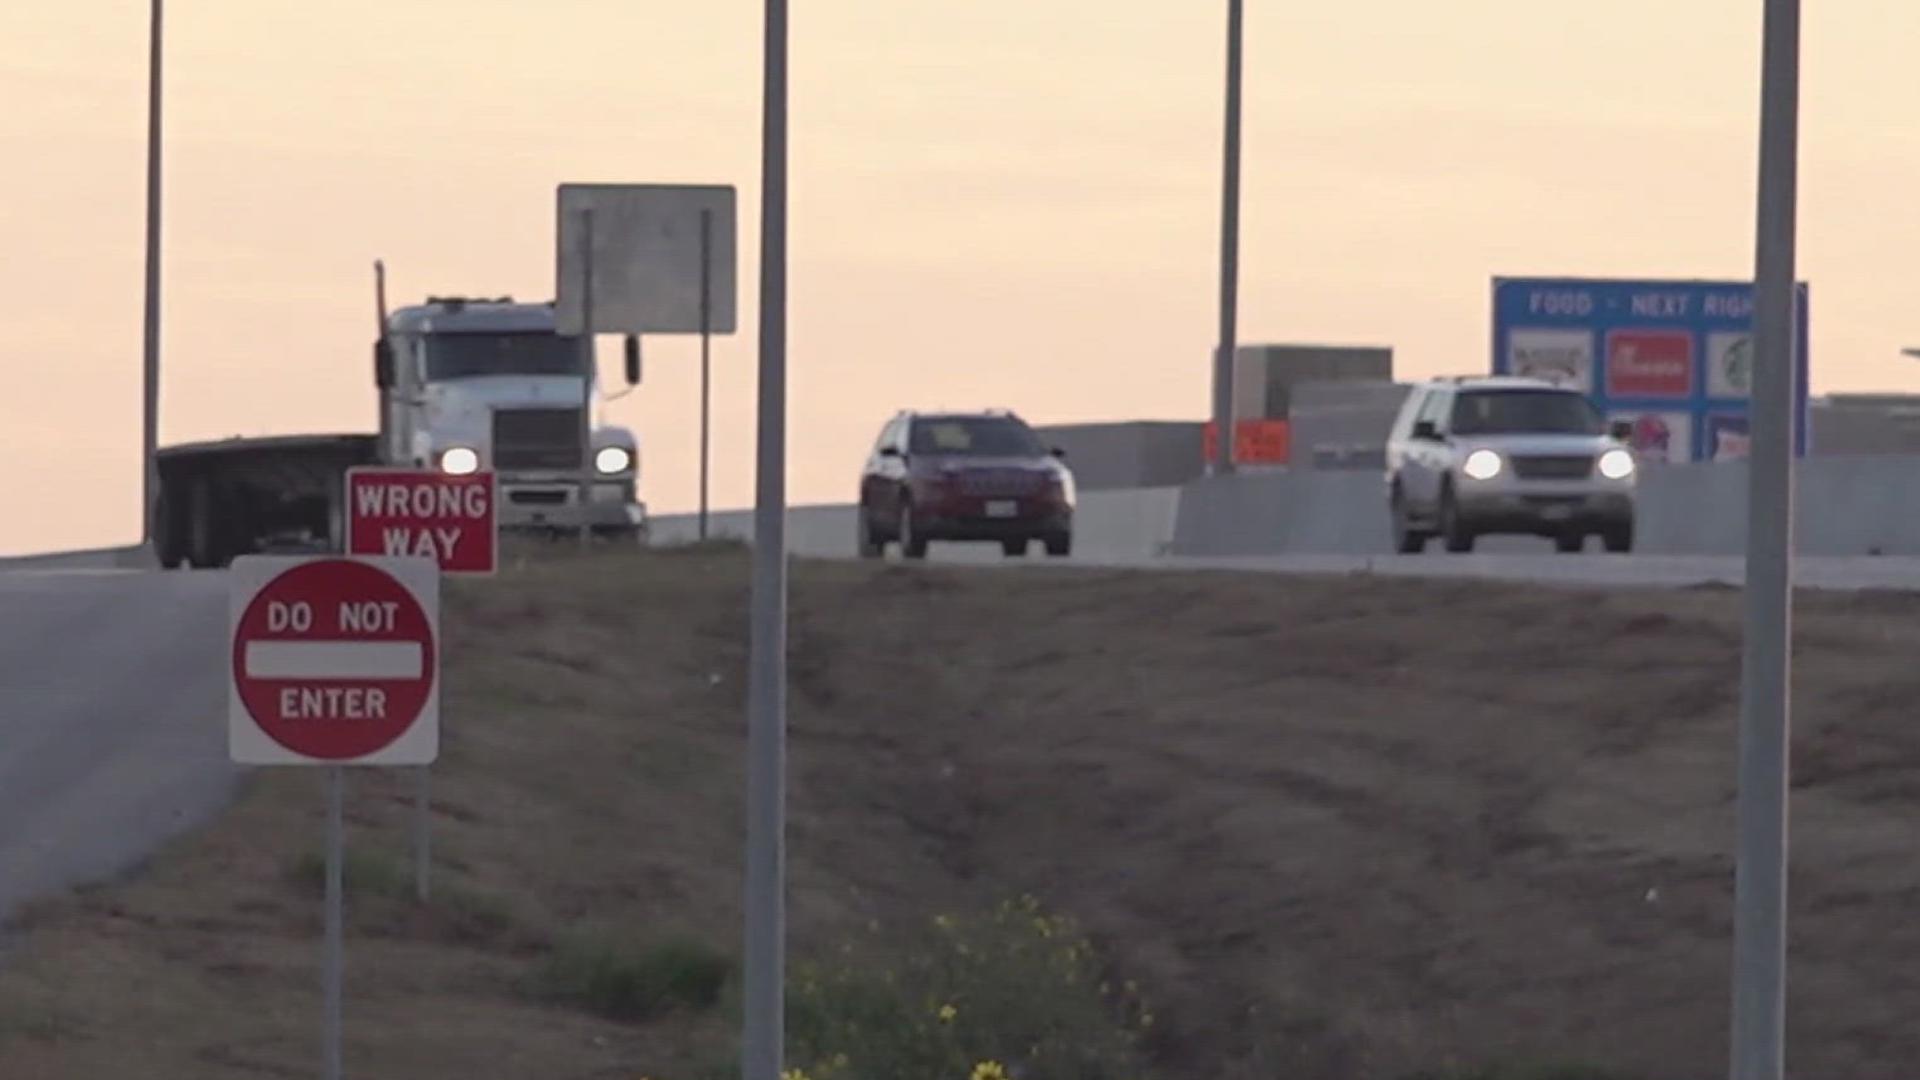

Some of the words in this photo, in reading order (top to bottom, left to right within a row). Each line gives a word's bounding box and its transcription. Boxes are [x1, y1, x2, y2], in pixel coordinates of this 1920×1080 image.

[1530, 291, 1592, 314] FOOD
[1631, 294, 1687, 316] NEXT
[1704, 295, 1755, 318] RIGH
[356, 484, 487, 519] WRONG
[382, 527, 462, 560] WAY
[267, 601, 312, 632] DO
[339, 601, 399, 632] NOT
[280, 687, 387, 719] ENTER
